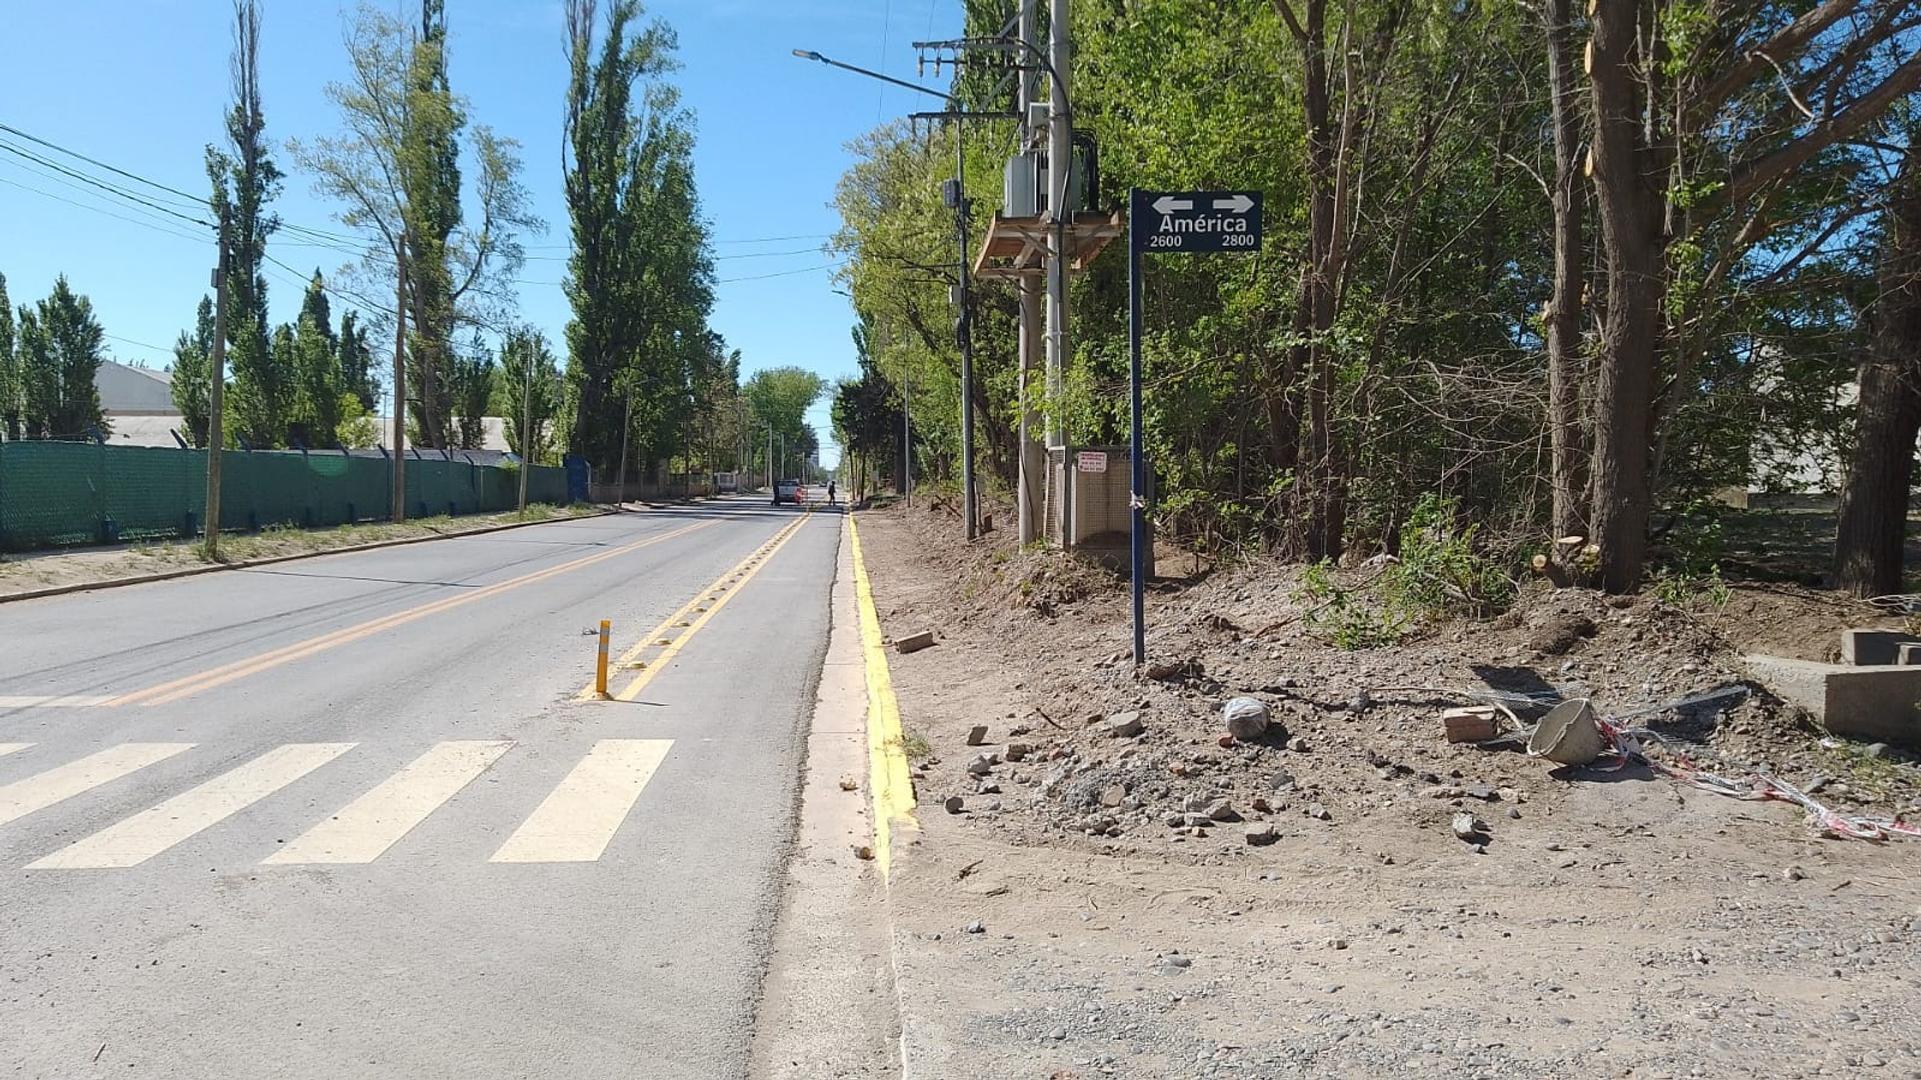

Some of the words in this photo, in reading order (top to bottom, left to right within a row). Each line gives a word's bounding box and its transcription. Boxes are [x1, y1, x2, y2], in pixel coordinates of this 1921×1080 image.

[1159, 214, 1247, 232] América
[1150, 235, 1182, 247] 2600
[1222, 234, 1255, 246] 2800
